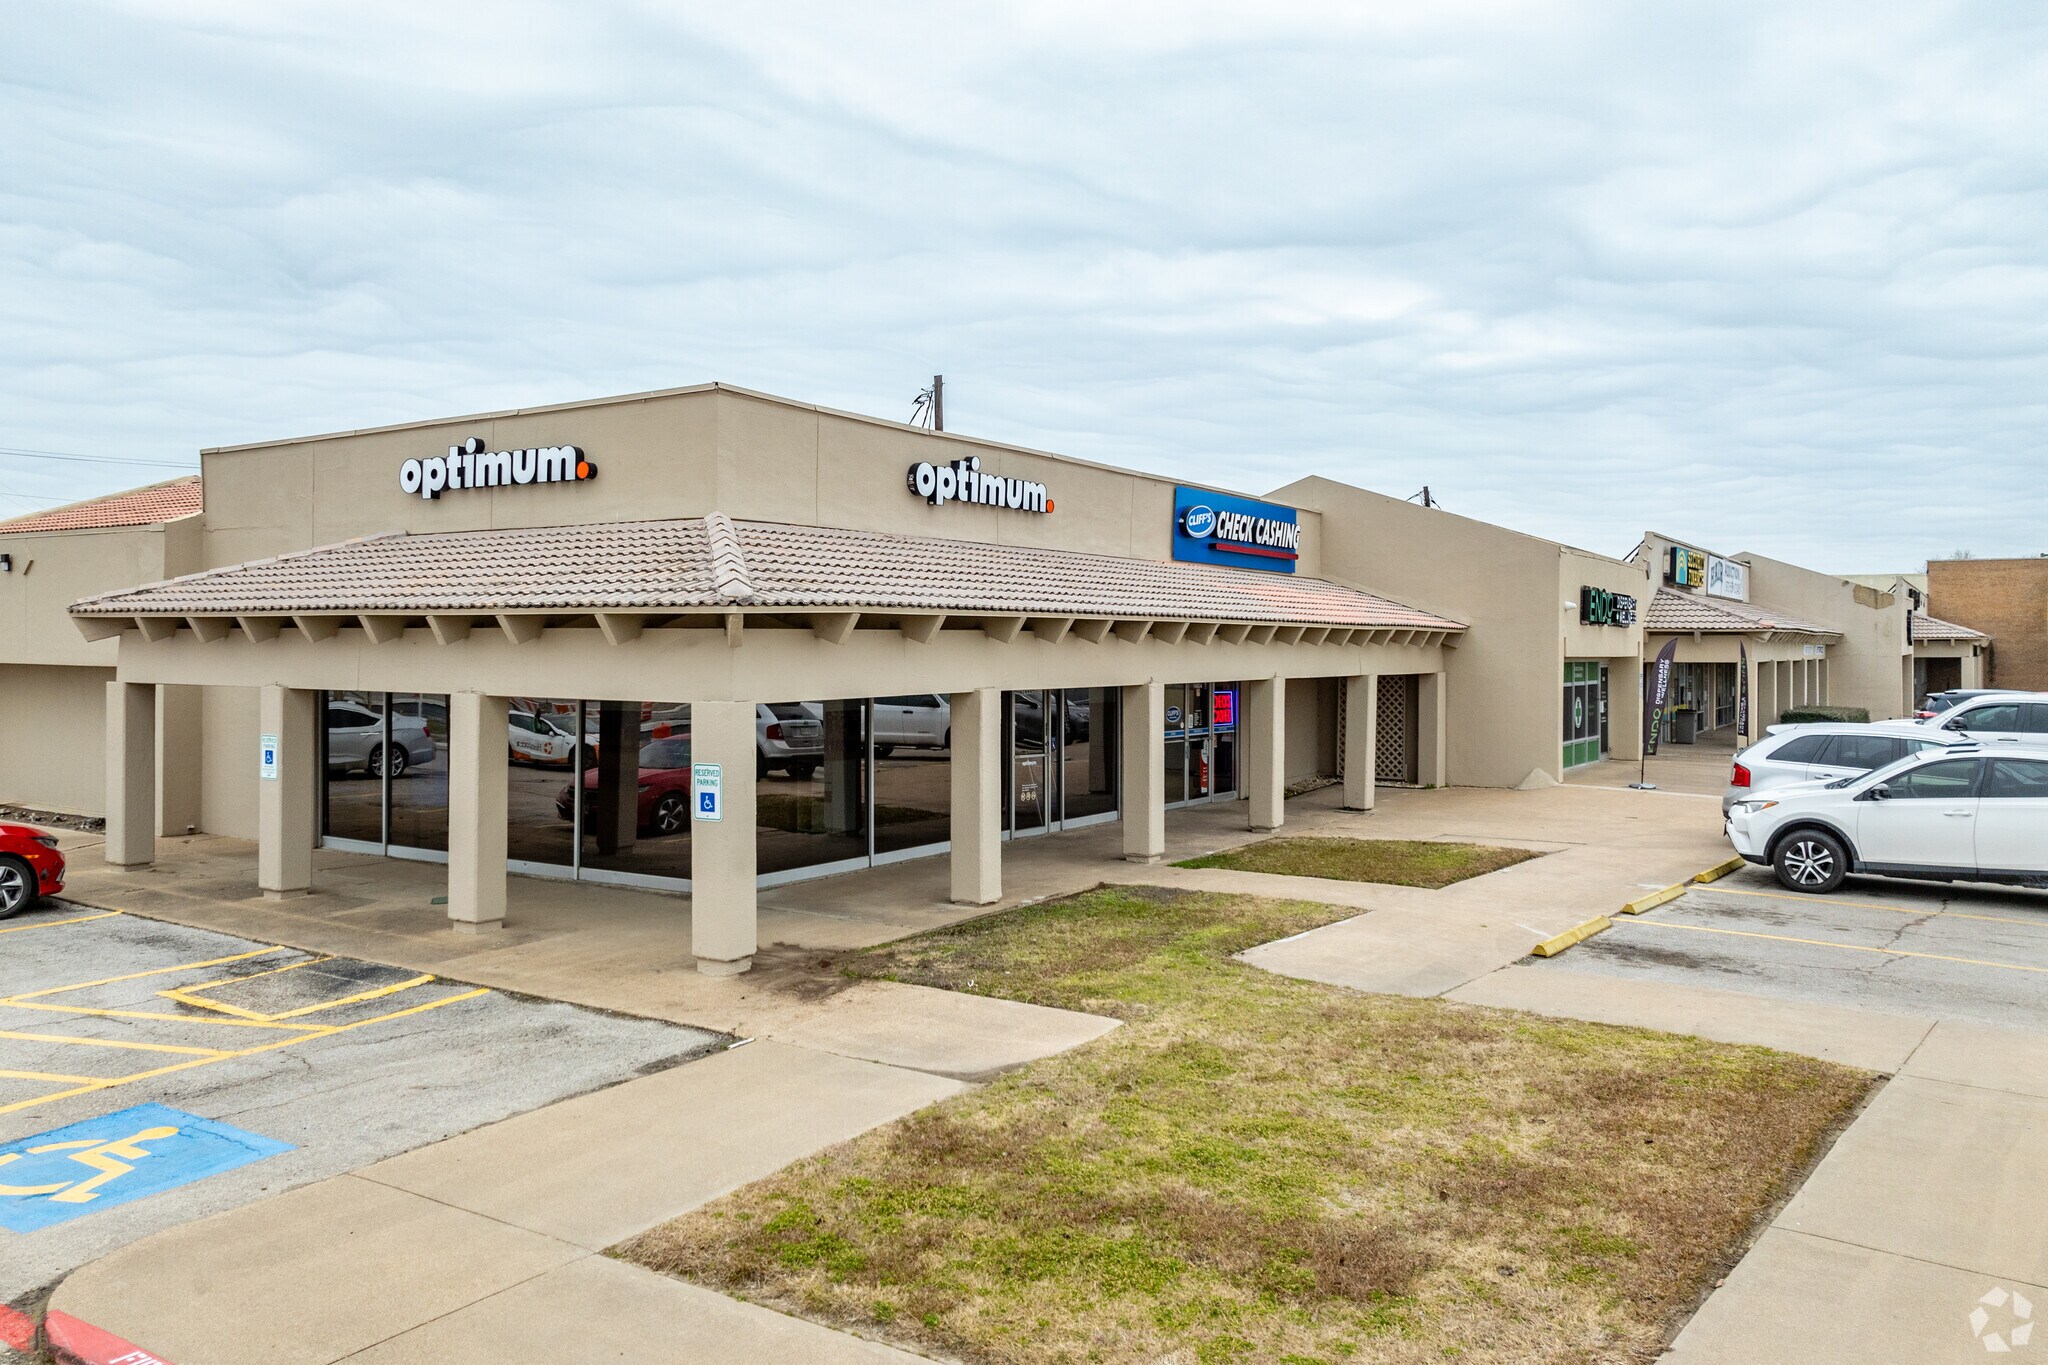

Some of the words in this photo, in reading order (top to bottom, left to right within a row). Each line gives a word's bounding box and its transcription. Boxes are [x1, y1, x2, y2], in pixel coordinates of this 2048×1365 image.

[1217, 511, 1256, 543] CHECK
[1256, 518, 1301, 550] CASHING
[1655, 658, 1665, 705] DISPENSARY
[694, 768, 721, 777] RESERVED
[697, 778, 719, 787] PARKING
